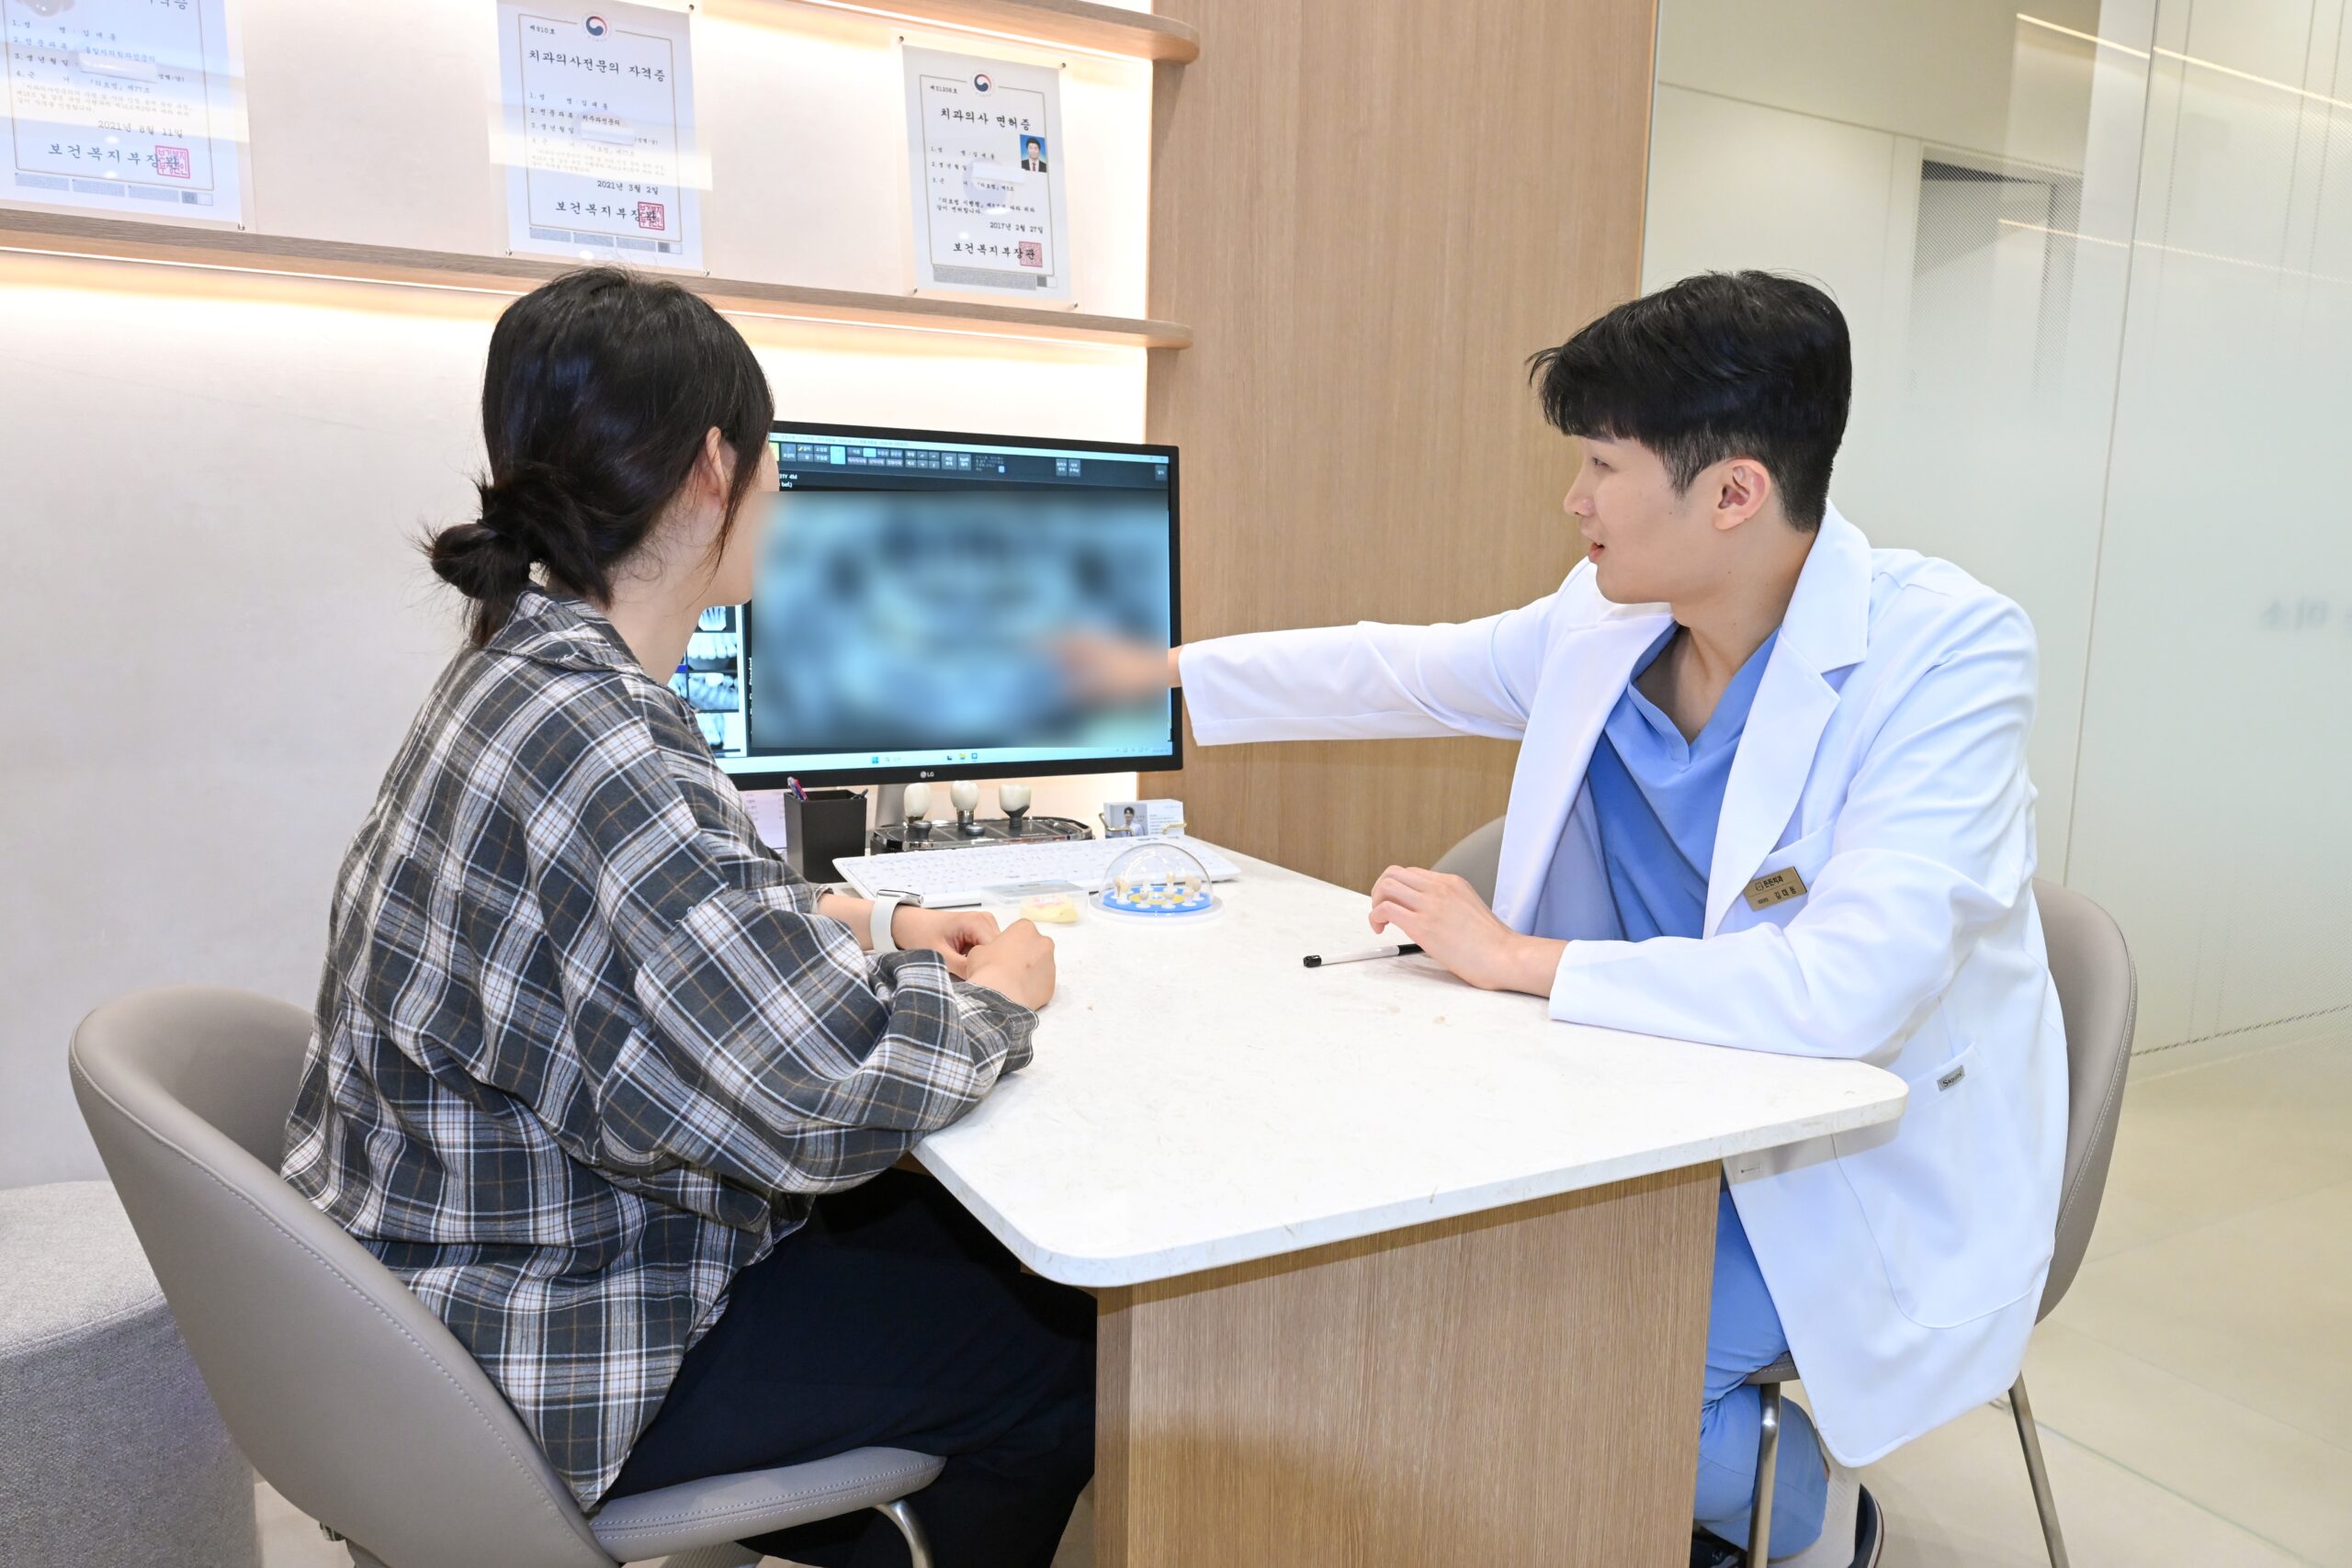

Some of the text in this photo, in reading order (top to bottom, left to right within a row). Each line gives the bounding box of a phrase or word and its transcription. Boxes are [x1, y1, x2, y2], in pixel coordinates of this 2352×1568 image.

[529, 50, 665, 83] 치과의사전문의 자격증
[941, 107, 1031, 131] 치과의사 면허증
[597, 180, 624, 192] 2021년
